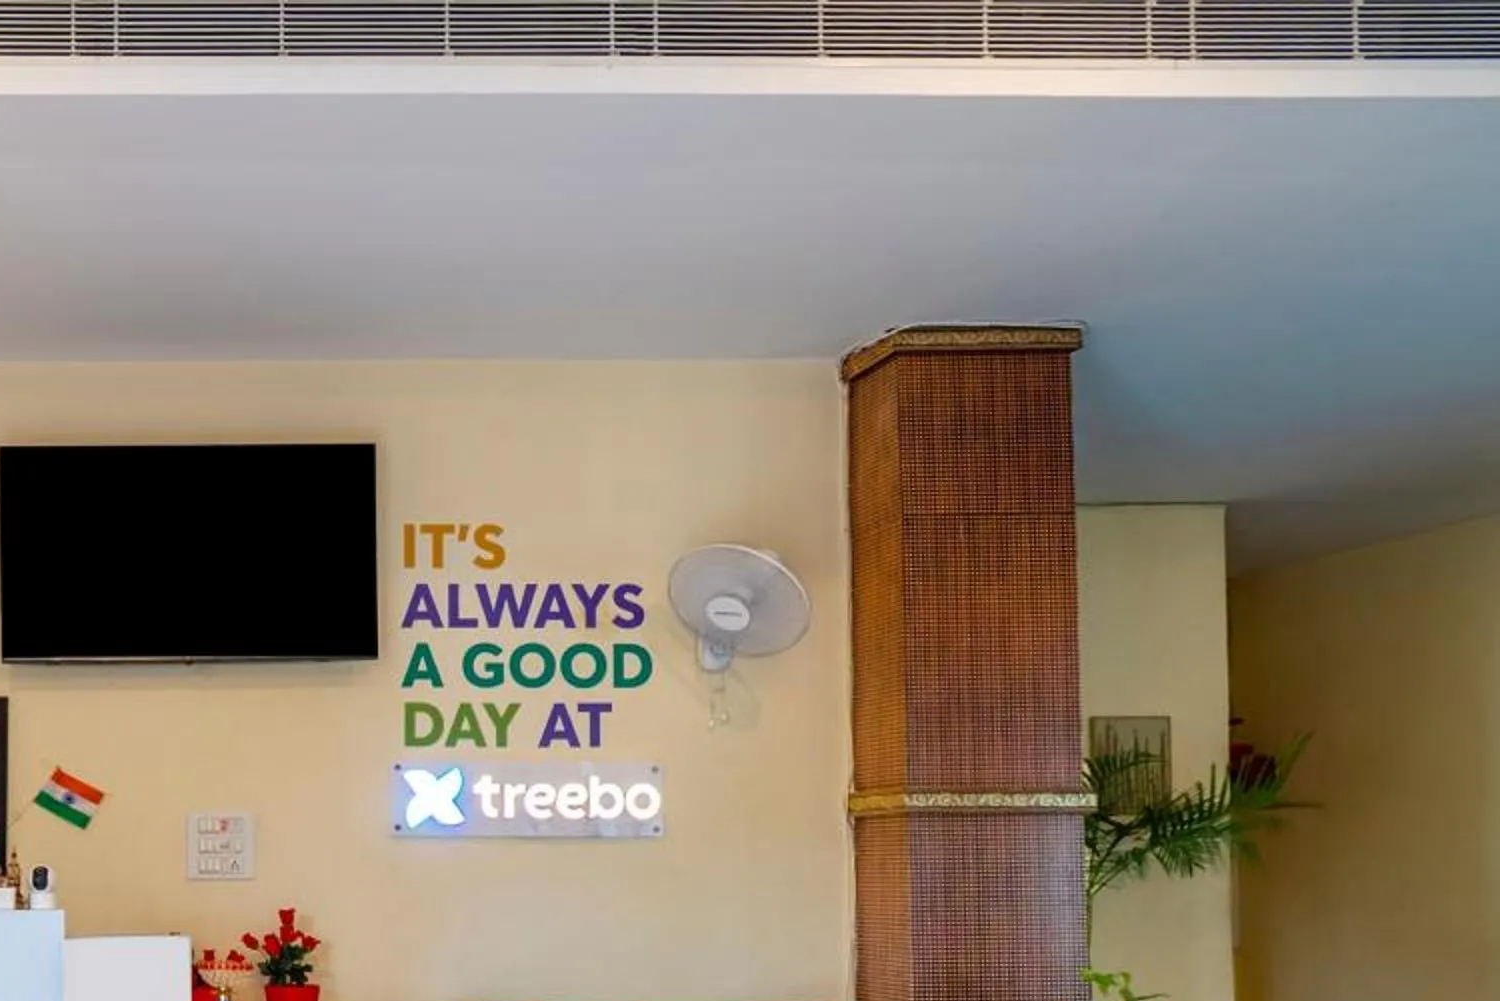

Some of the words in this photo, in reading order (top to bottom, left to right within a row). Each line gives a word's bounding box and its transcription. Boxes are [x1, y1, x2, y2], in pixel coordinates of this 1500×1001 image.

[403, 523, 506, 569] IT'S
[401, 583, 645, 629] ALWAYS
[401, 642, 443, 688] A
[461, 642, 653, 688] GOOD
[403, 702, 521, 748] DAY
[537, 702, 613, 748] AT
[473, 775, 661, 820] treebo
